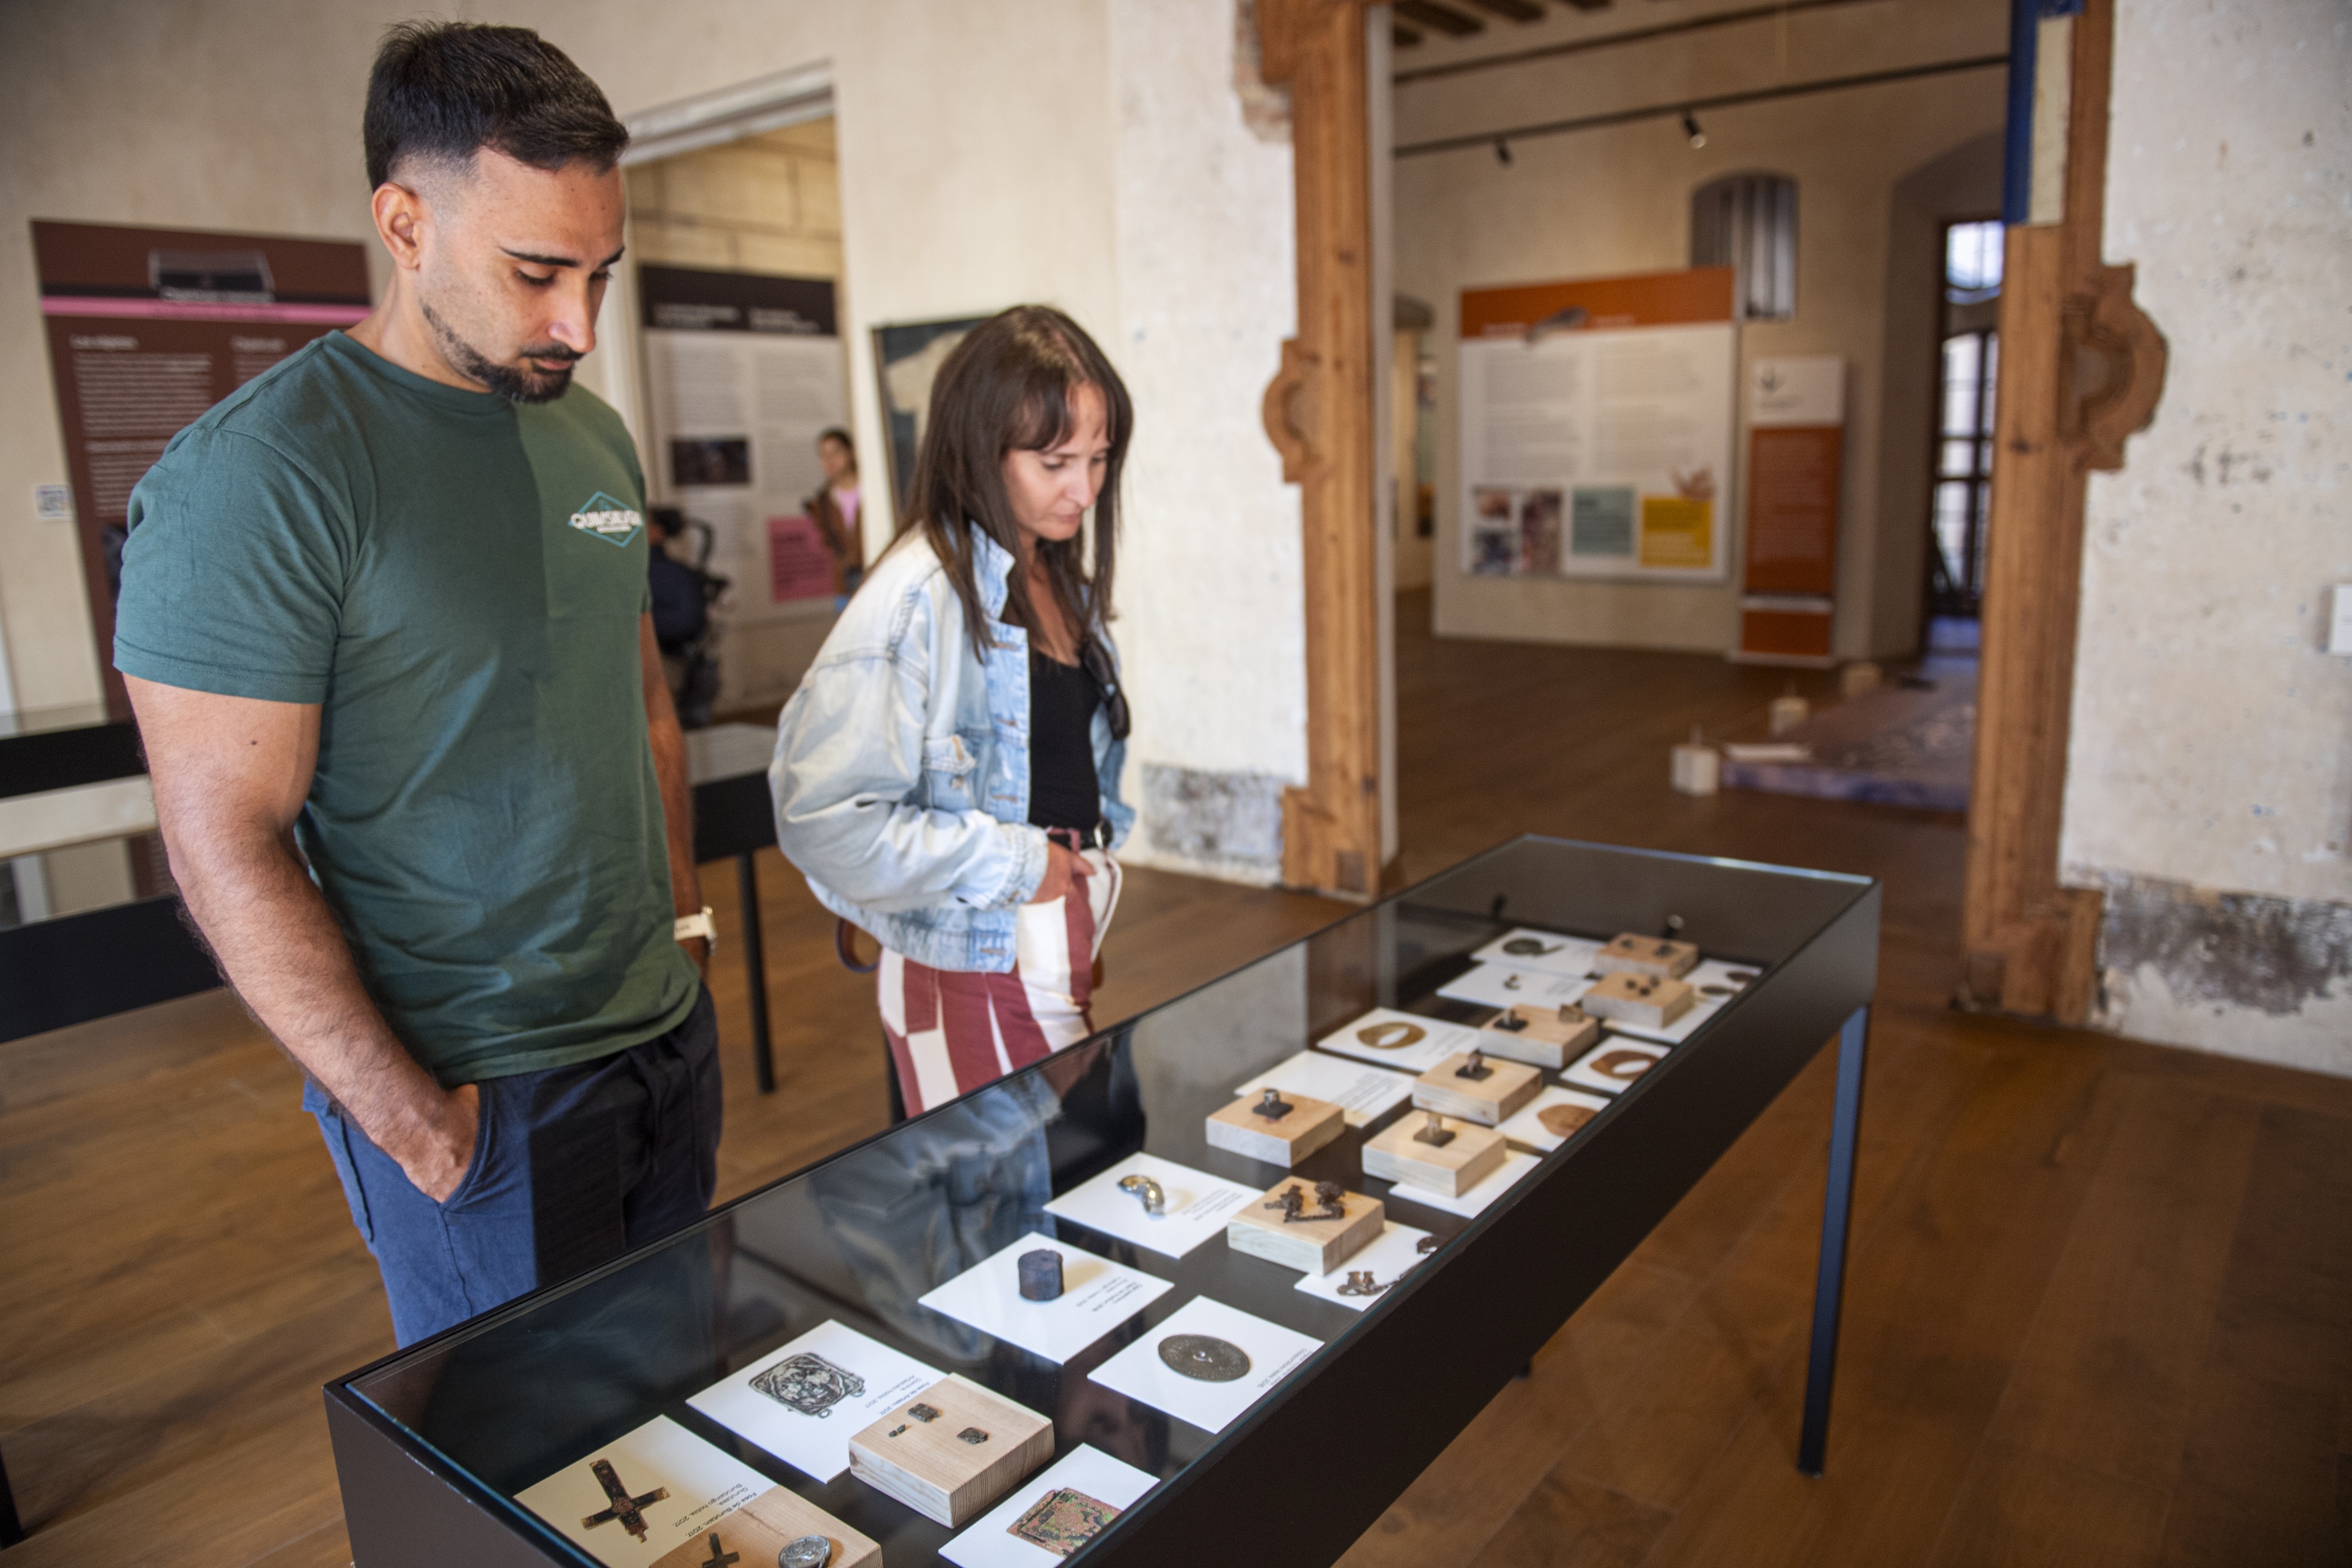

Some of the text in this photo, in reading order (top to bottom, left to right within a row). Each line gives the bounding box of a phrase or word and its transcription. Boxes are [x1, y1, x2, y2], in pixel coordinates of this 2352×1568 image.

[672, 1483, 742, 1527] Burutaingo hobia. 2017.
[685, 1491, 757, 1537] Fosa de Burutain. 2017.
